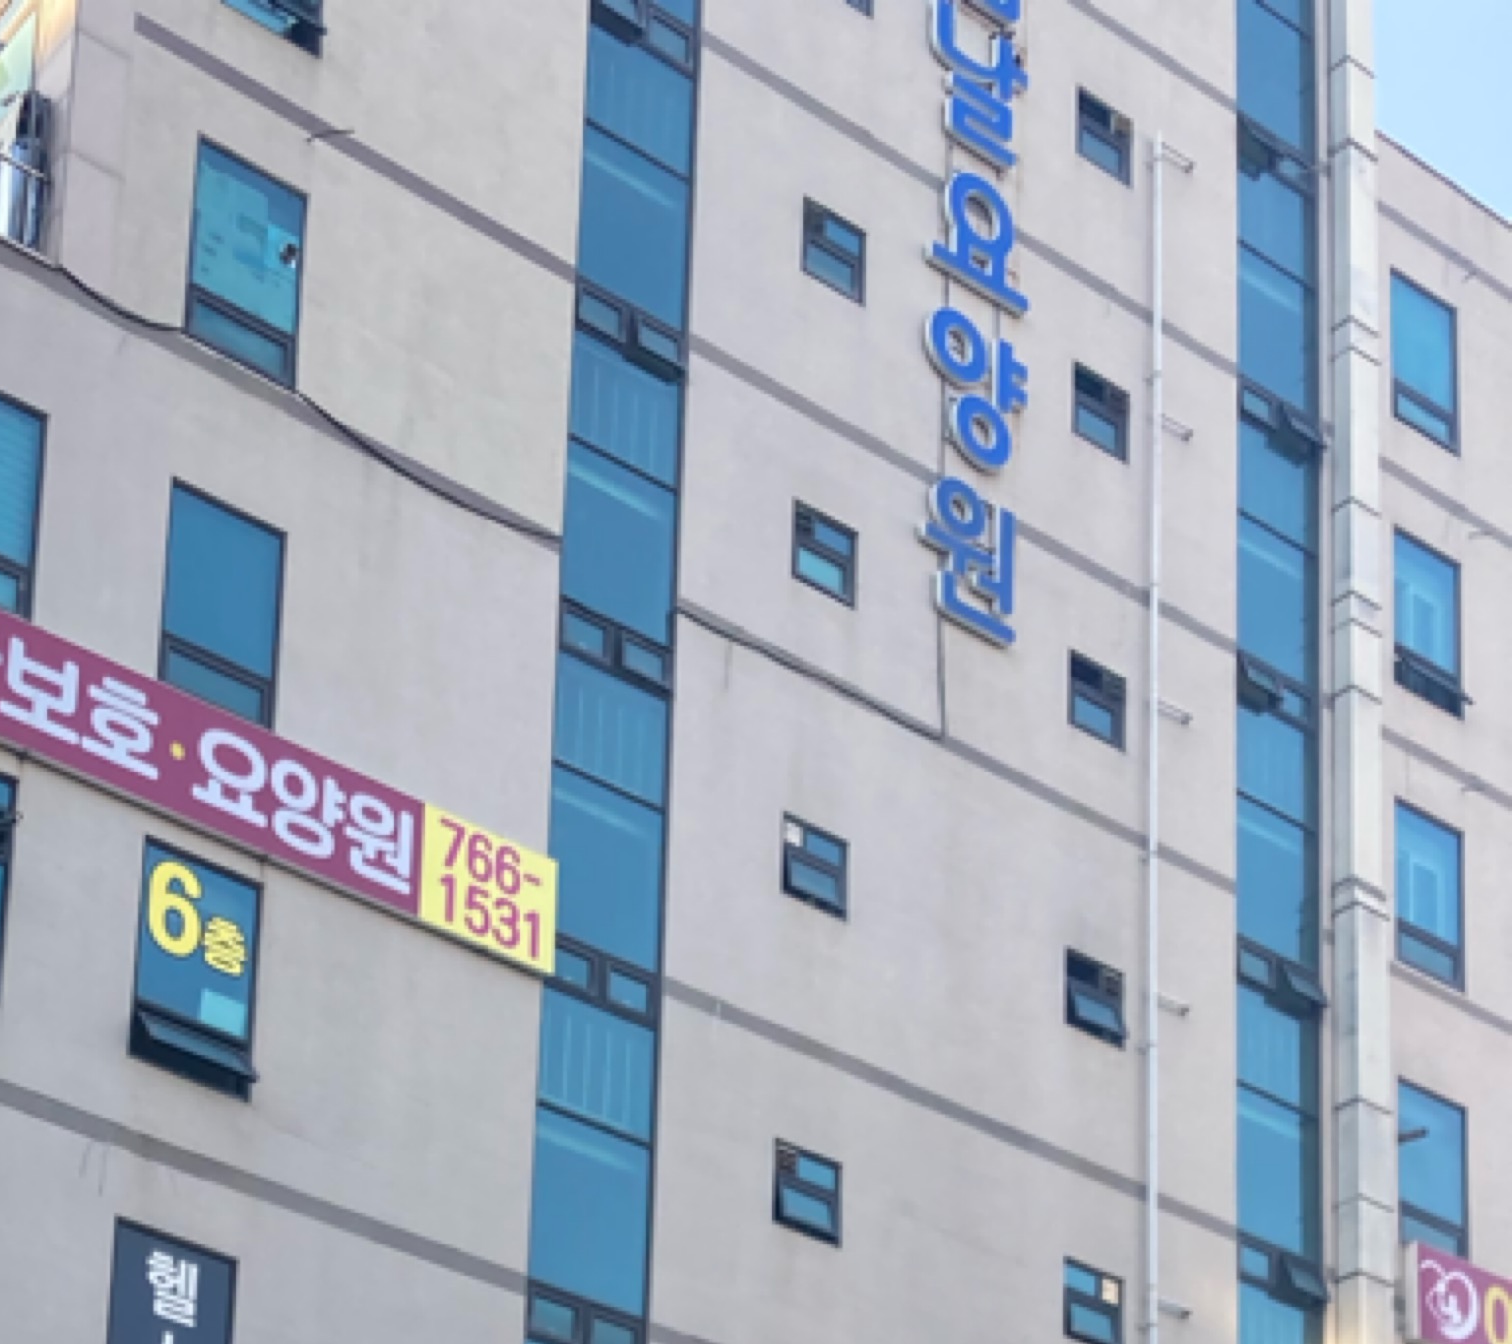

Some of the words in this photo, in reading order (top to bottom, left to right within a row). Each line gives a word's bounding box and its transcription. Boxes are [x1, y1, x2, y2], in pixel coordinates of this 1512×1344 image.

[439, 817, 544, 897] 766-
[146, 859, 249, 979] 6층
[438, 876, 541, 960] 1531
